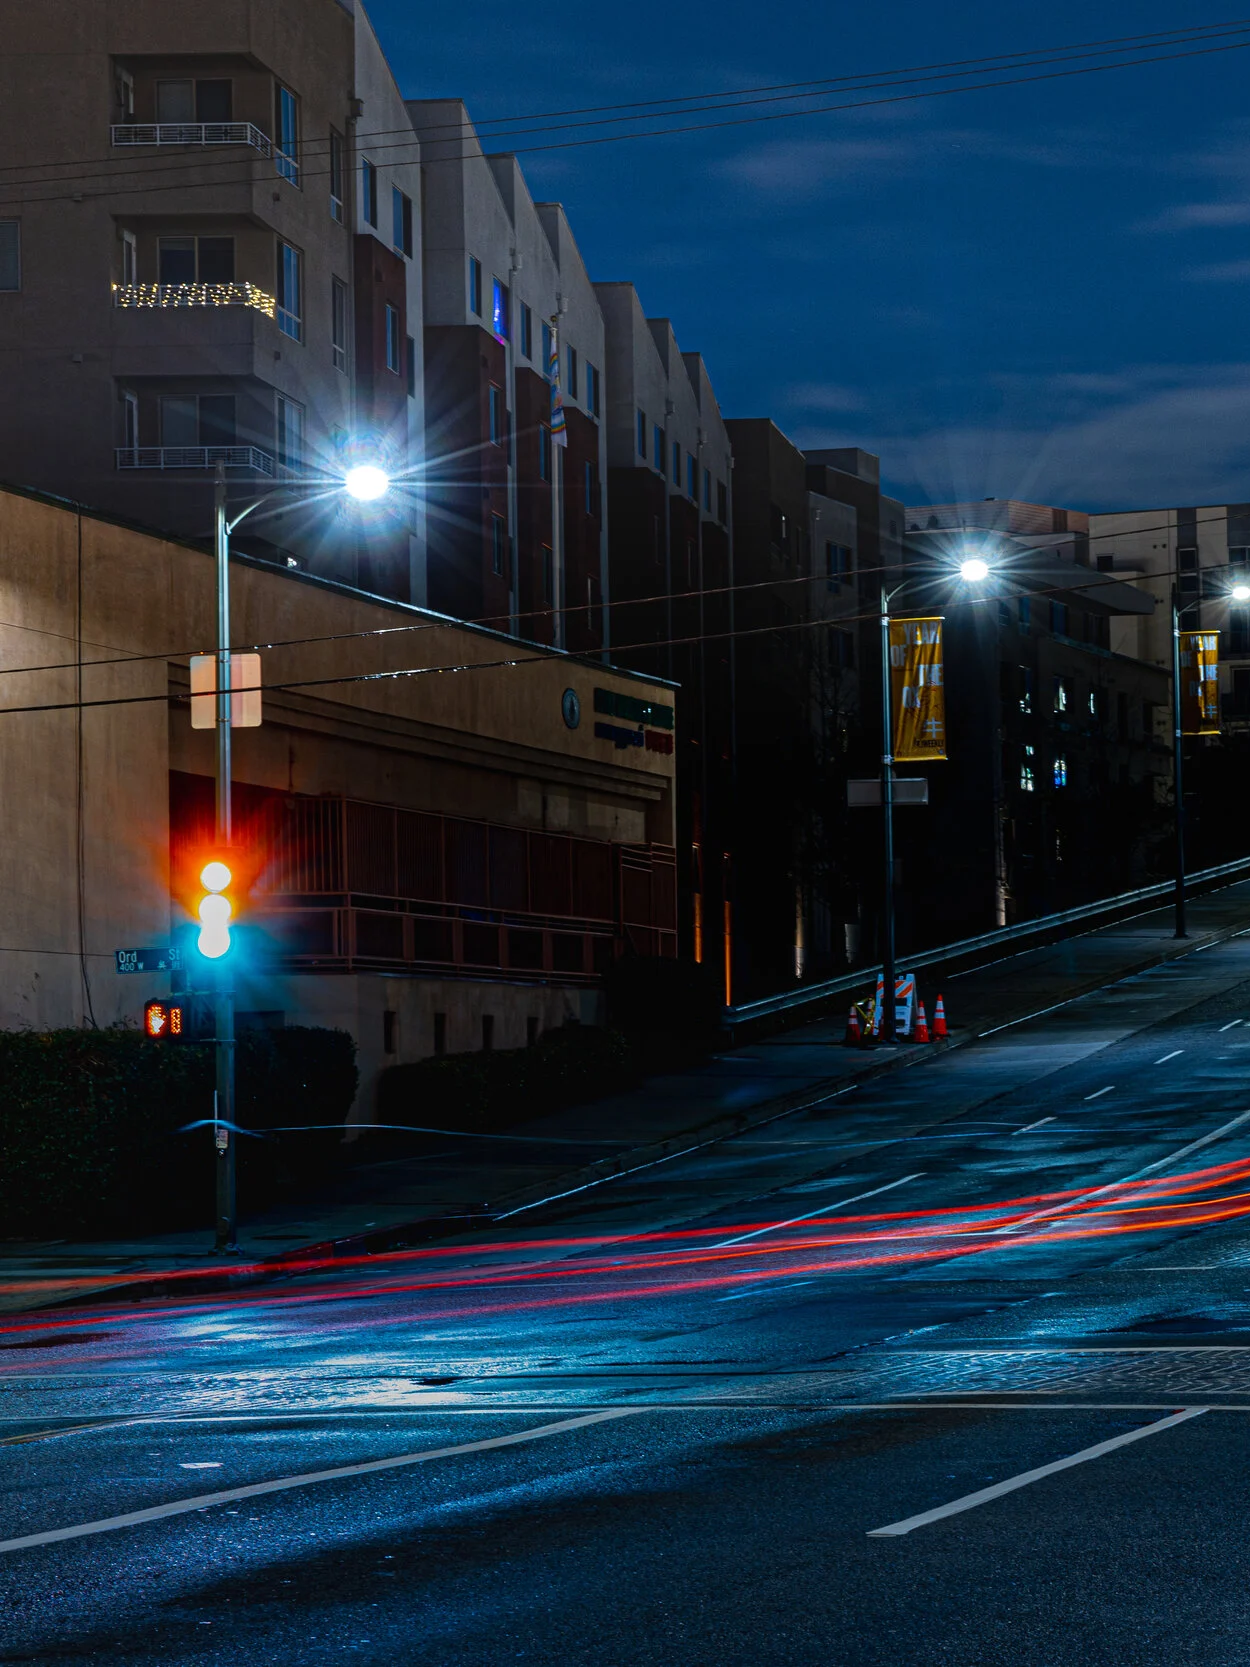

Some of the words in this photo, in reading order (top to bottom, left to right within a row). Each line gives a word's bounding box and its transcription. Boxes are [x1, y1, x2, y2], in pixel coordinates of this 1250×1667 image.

[904, 622, 941, 645] YEAR
[891, 644, 908, 667] OF
[918, 664, 944, 687] THE
[902, 686, 921, 709] OX
[922, 716, 944, 739] 牛
[119, 951, 137, 963] Ord
[169, 948, 180, 960] St
[120, 962, 134, 971] 400
[137, 962, 144, 970] W
